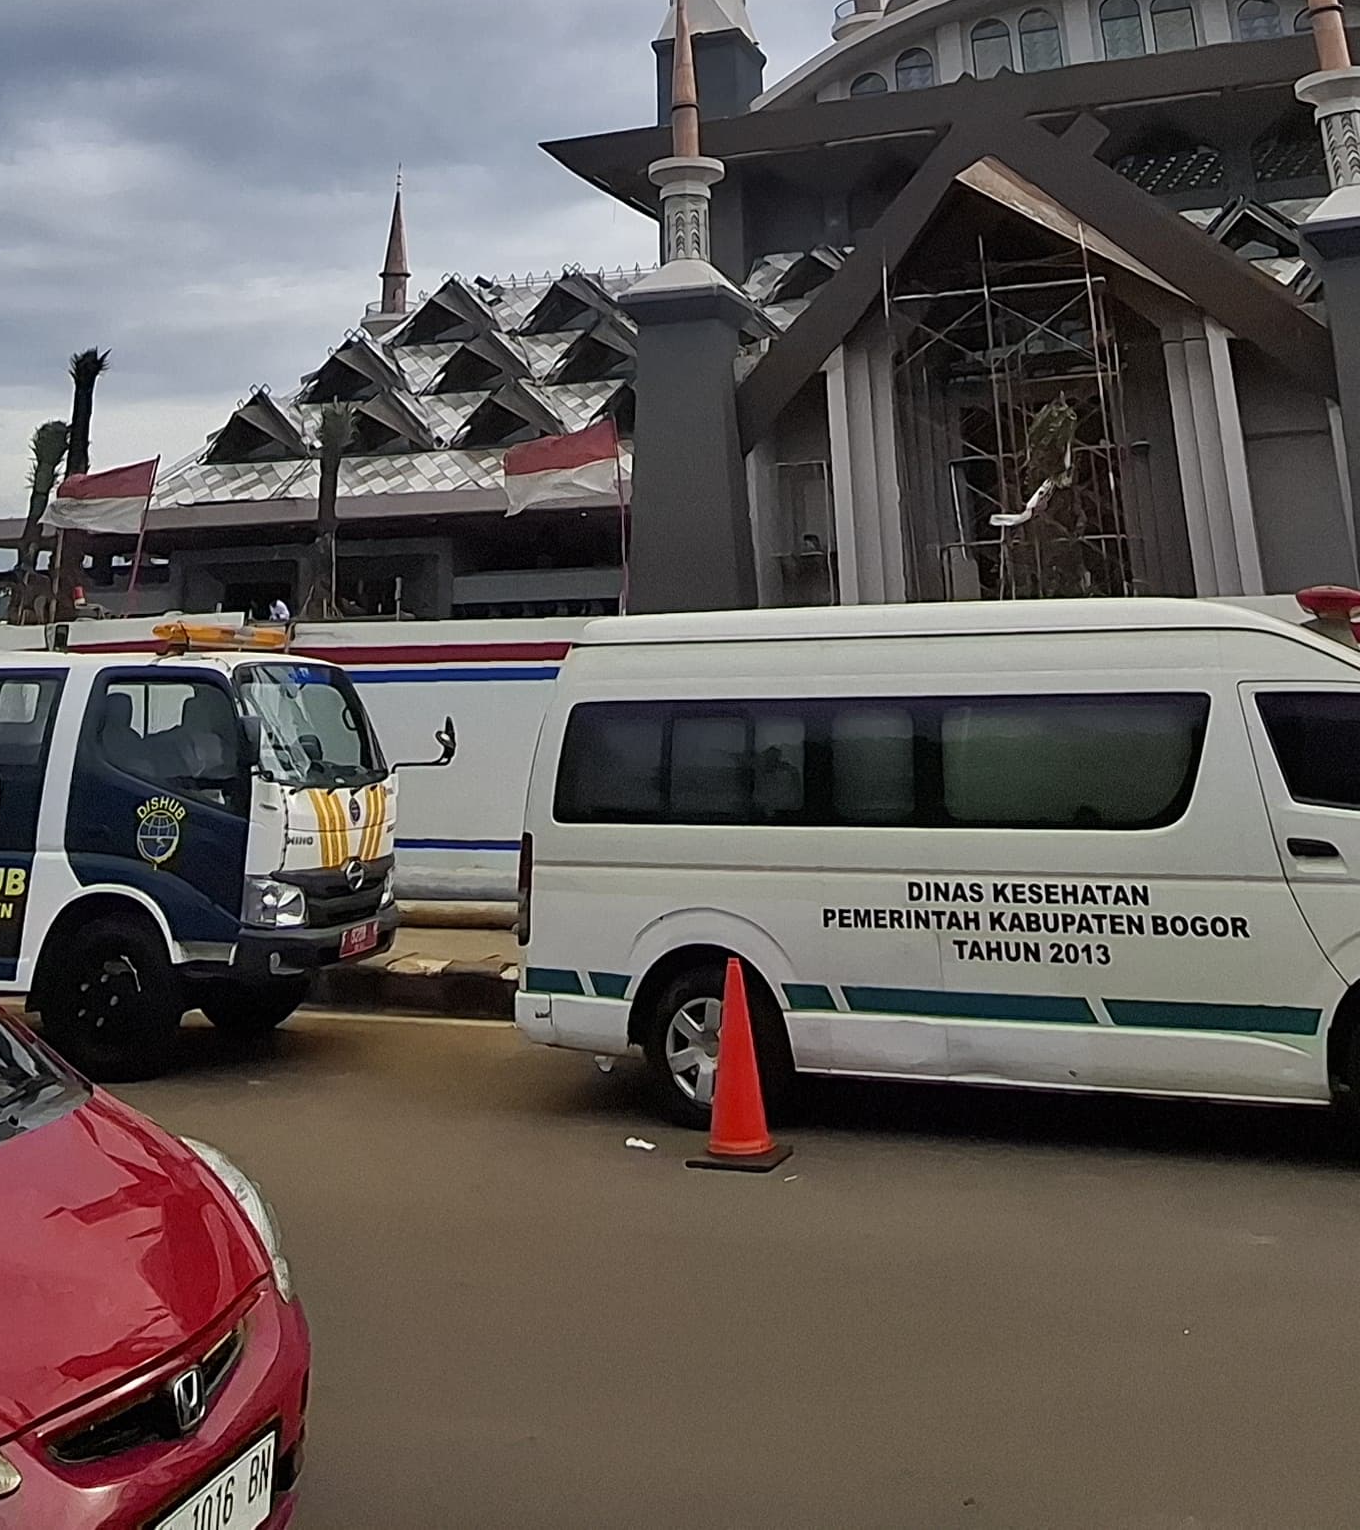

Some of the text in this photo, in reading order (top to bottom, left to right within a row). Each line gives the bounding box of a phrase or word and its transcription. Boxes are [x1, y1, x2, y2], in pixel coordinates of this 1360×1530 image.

[136, 796, 186, 820] DISHUB
[907, 882, 1150, 906] DINAS KESEHATAN
[822, 909, 1250, 938] PEMERINTAH KABUPATEN BOGOR
[953, 940, 1111, 965] TAHUN 2013
[193, 1444, 272, 1530] 1016 BN
